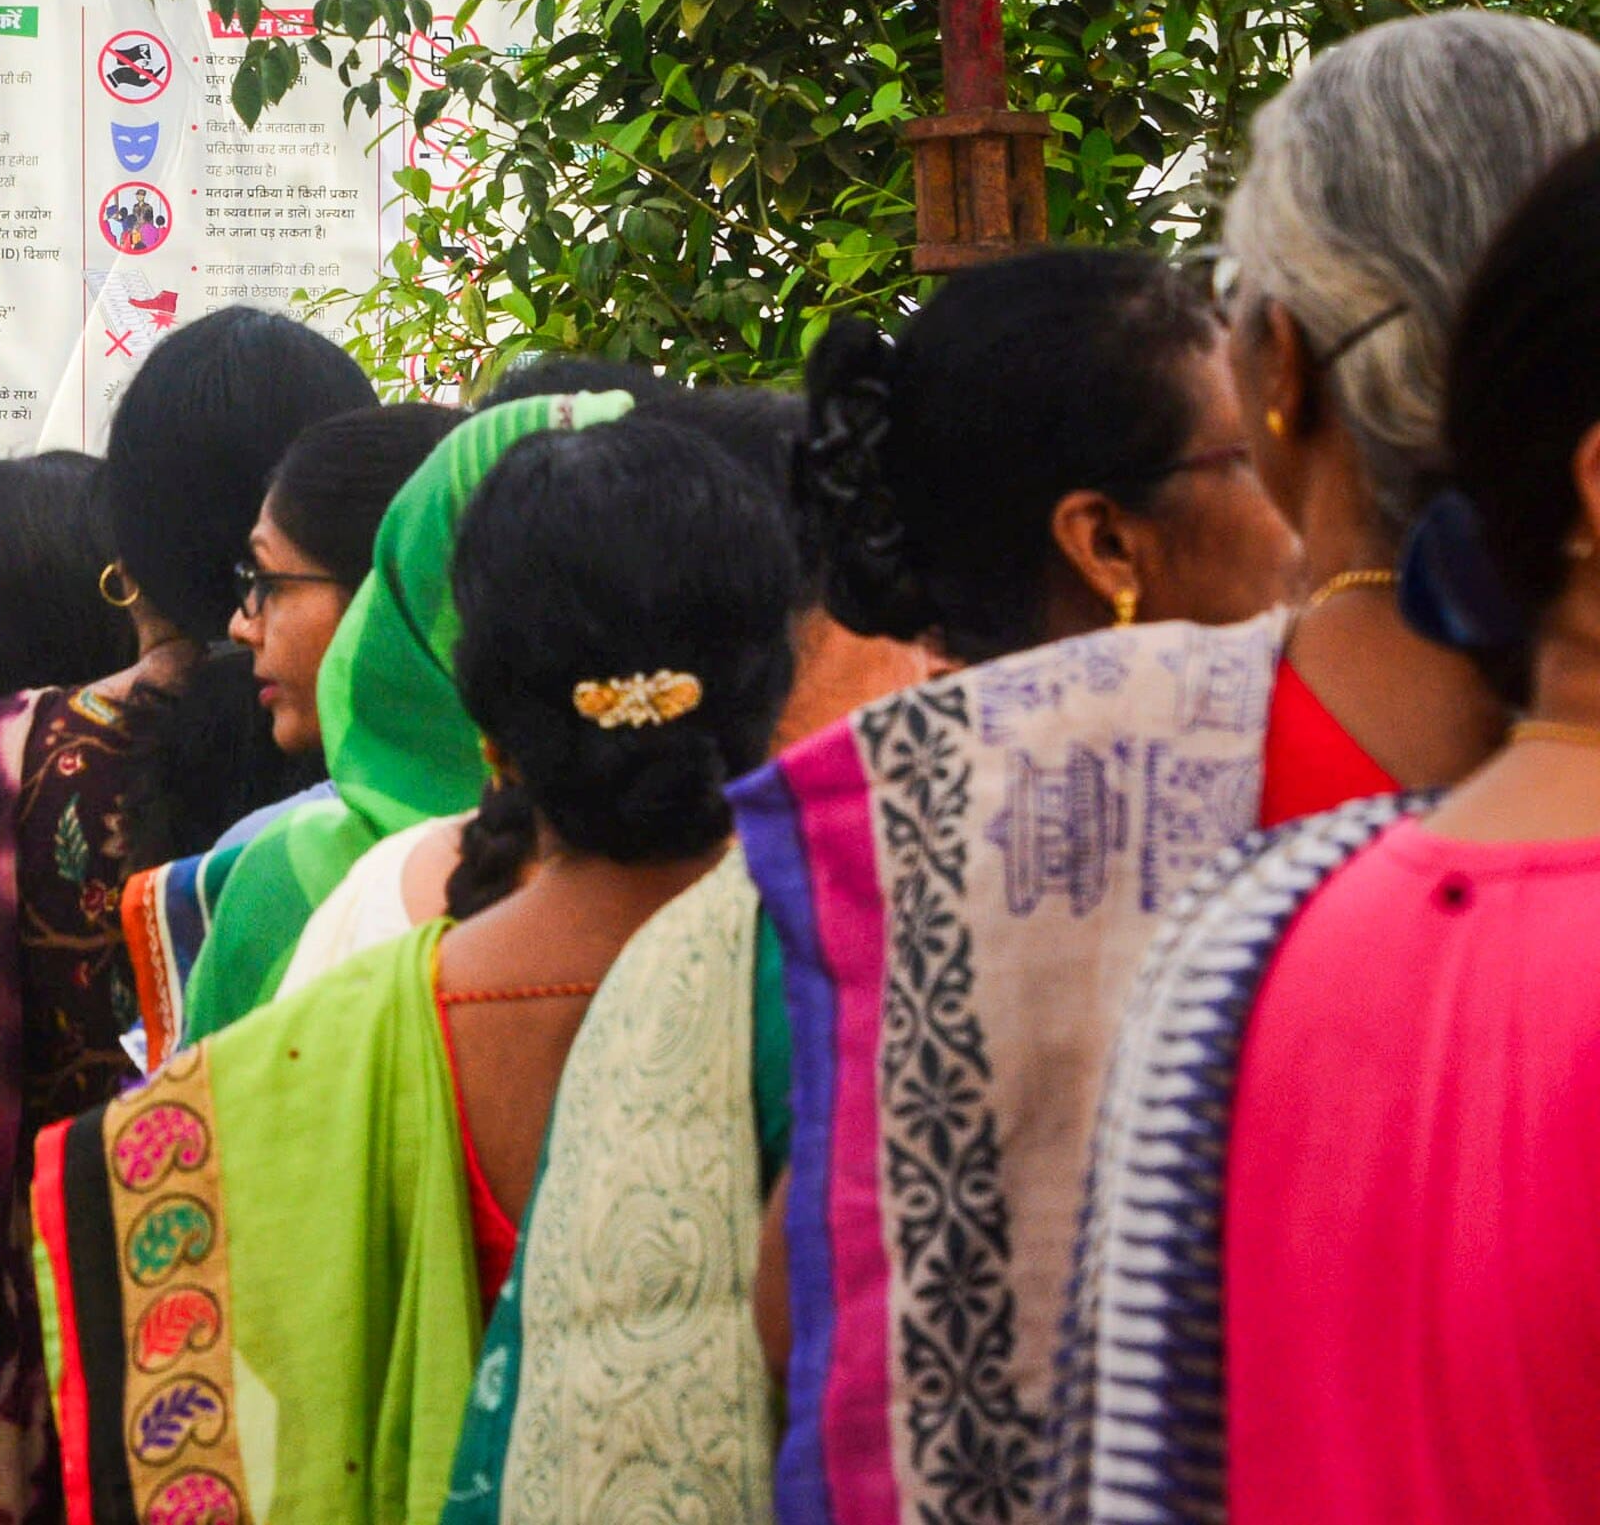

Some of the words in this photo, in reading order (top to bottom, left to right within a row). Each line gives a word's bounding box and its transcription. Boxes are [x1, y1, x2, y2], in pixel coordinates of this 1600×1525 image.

[16, 70, 32, 85] की
[309, 123, 325, 134] का
[278, 144, 297, 155] मत
[8, 153, 39, 168] हमेशा
[205, 164, 223, 177] यह
[225, 164, 263, 177] अपराध
[206, 187, 243, 199] मतदान
[246, 184, 283, 199] प्रक्रिया
[298, 185, 327, 200] किसी
[329, 189, 359, 200] प्रकार
[14, 206, 51, 220] आयोग
[206, 207, 219, 219] का
[223, 207, 272, 219] व्यवधान
[315, 208, 355, 220] अन्यथा
[13, 227, 37, 240] फोटो
[205, 223, 226, 238] जेल
[229, 227, 257, 238] जाना
[279, 227, 312, 239] सकता
[205, 264, 245, 277] मतदान
[300, 262, 316, 277] की
[221, 284, 249, 298] उनसे
[0, 386, 10, 401] के
[13, 389, 37, 400] साथ
